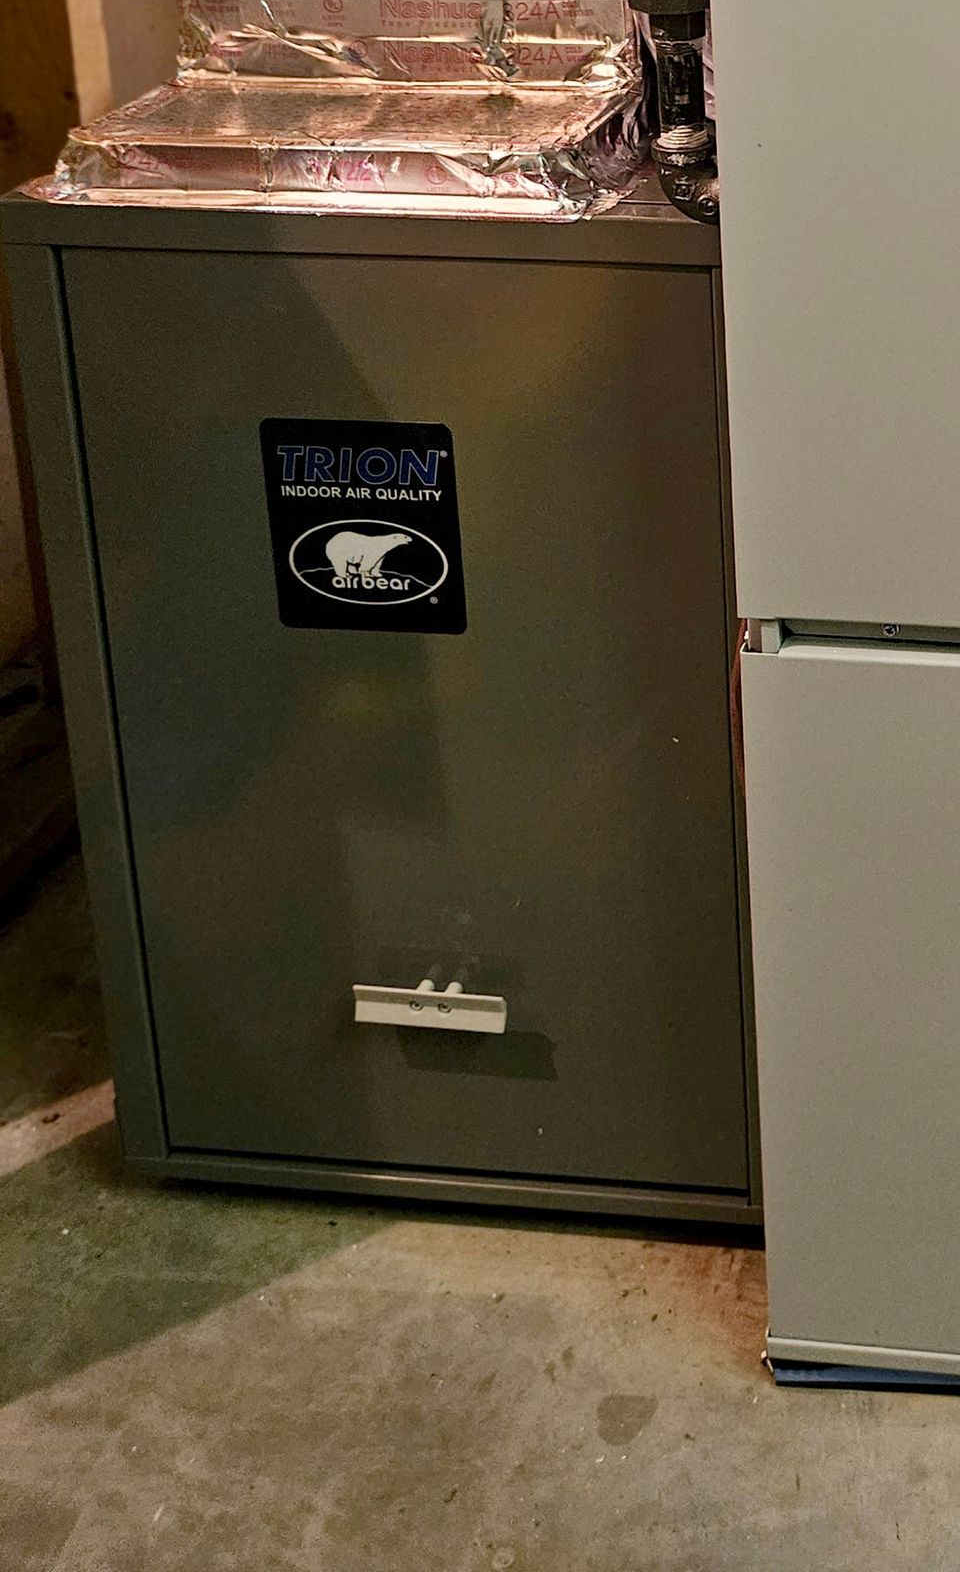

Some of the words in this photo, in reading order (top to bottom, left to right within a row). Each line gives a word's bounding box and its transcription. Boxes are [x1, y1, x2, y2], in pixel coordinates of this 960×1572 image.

[383, 39, 482, 65] Nashua
[277, 445, 439, 486] TRION
[280, 485, 341, 498] INDOOR
[345, 487, 371, 499] AIR
[375, 489, 442, 501] QUALITY
[332, 573, 411, 591] airbear
